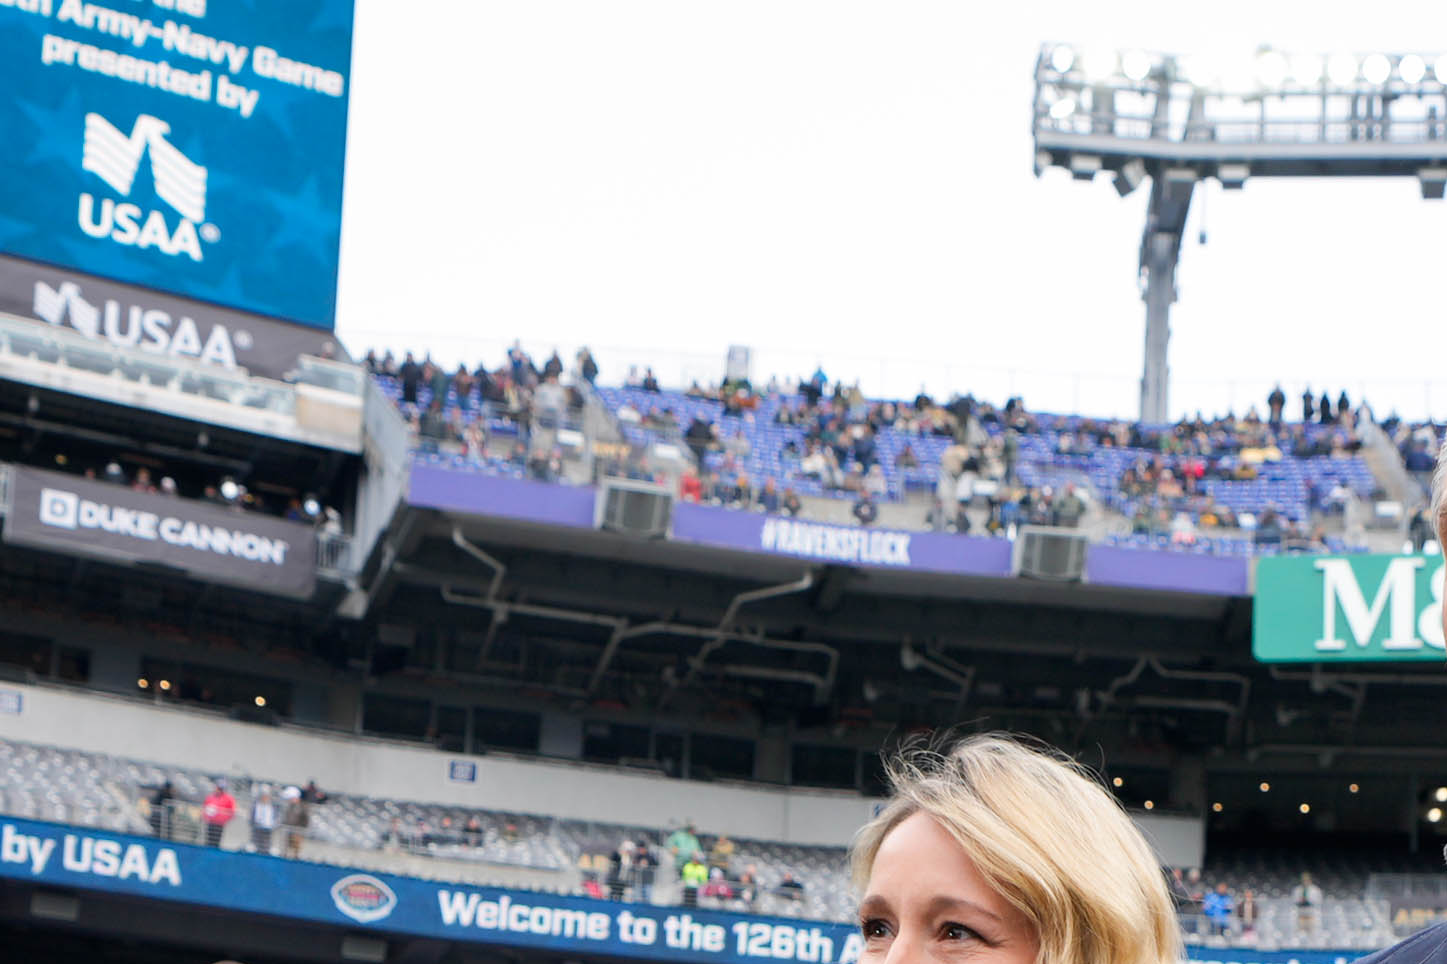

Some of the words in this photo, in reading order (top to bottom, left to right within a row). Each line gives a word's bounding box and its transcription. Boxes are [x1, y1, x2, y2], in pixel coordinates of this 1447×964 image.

[41, 34, 212, 101] presented
[216, 74, 260, 117] by
[252, 45, 344, 97] Game
[79, 500, 158, 540] DUKE
[159, 517, 287, 565] CANNON
[760, 517, 911, 566] #RAVENSFLOCK
[1, 825, 55, 874] by
[62, 834, 182, 886] USAA
[437, 890, 610, 940] Welcome
[617, 911, 657, 946] to
[664, 915, 726, 952] the
[732, 921, 833, 964] 126th
